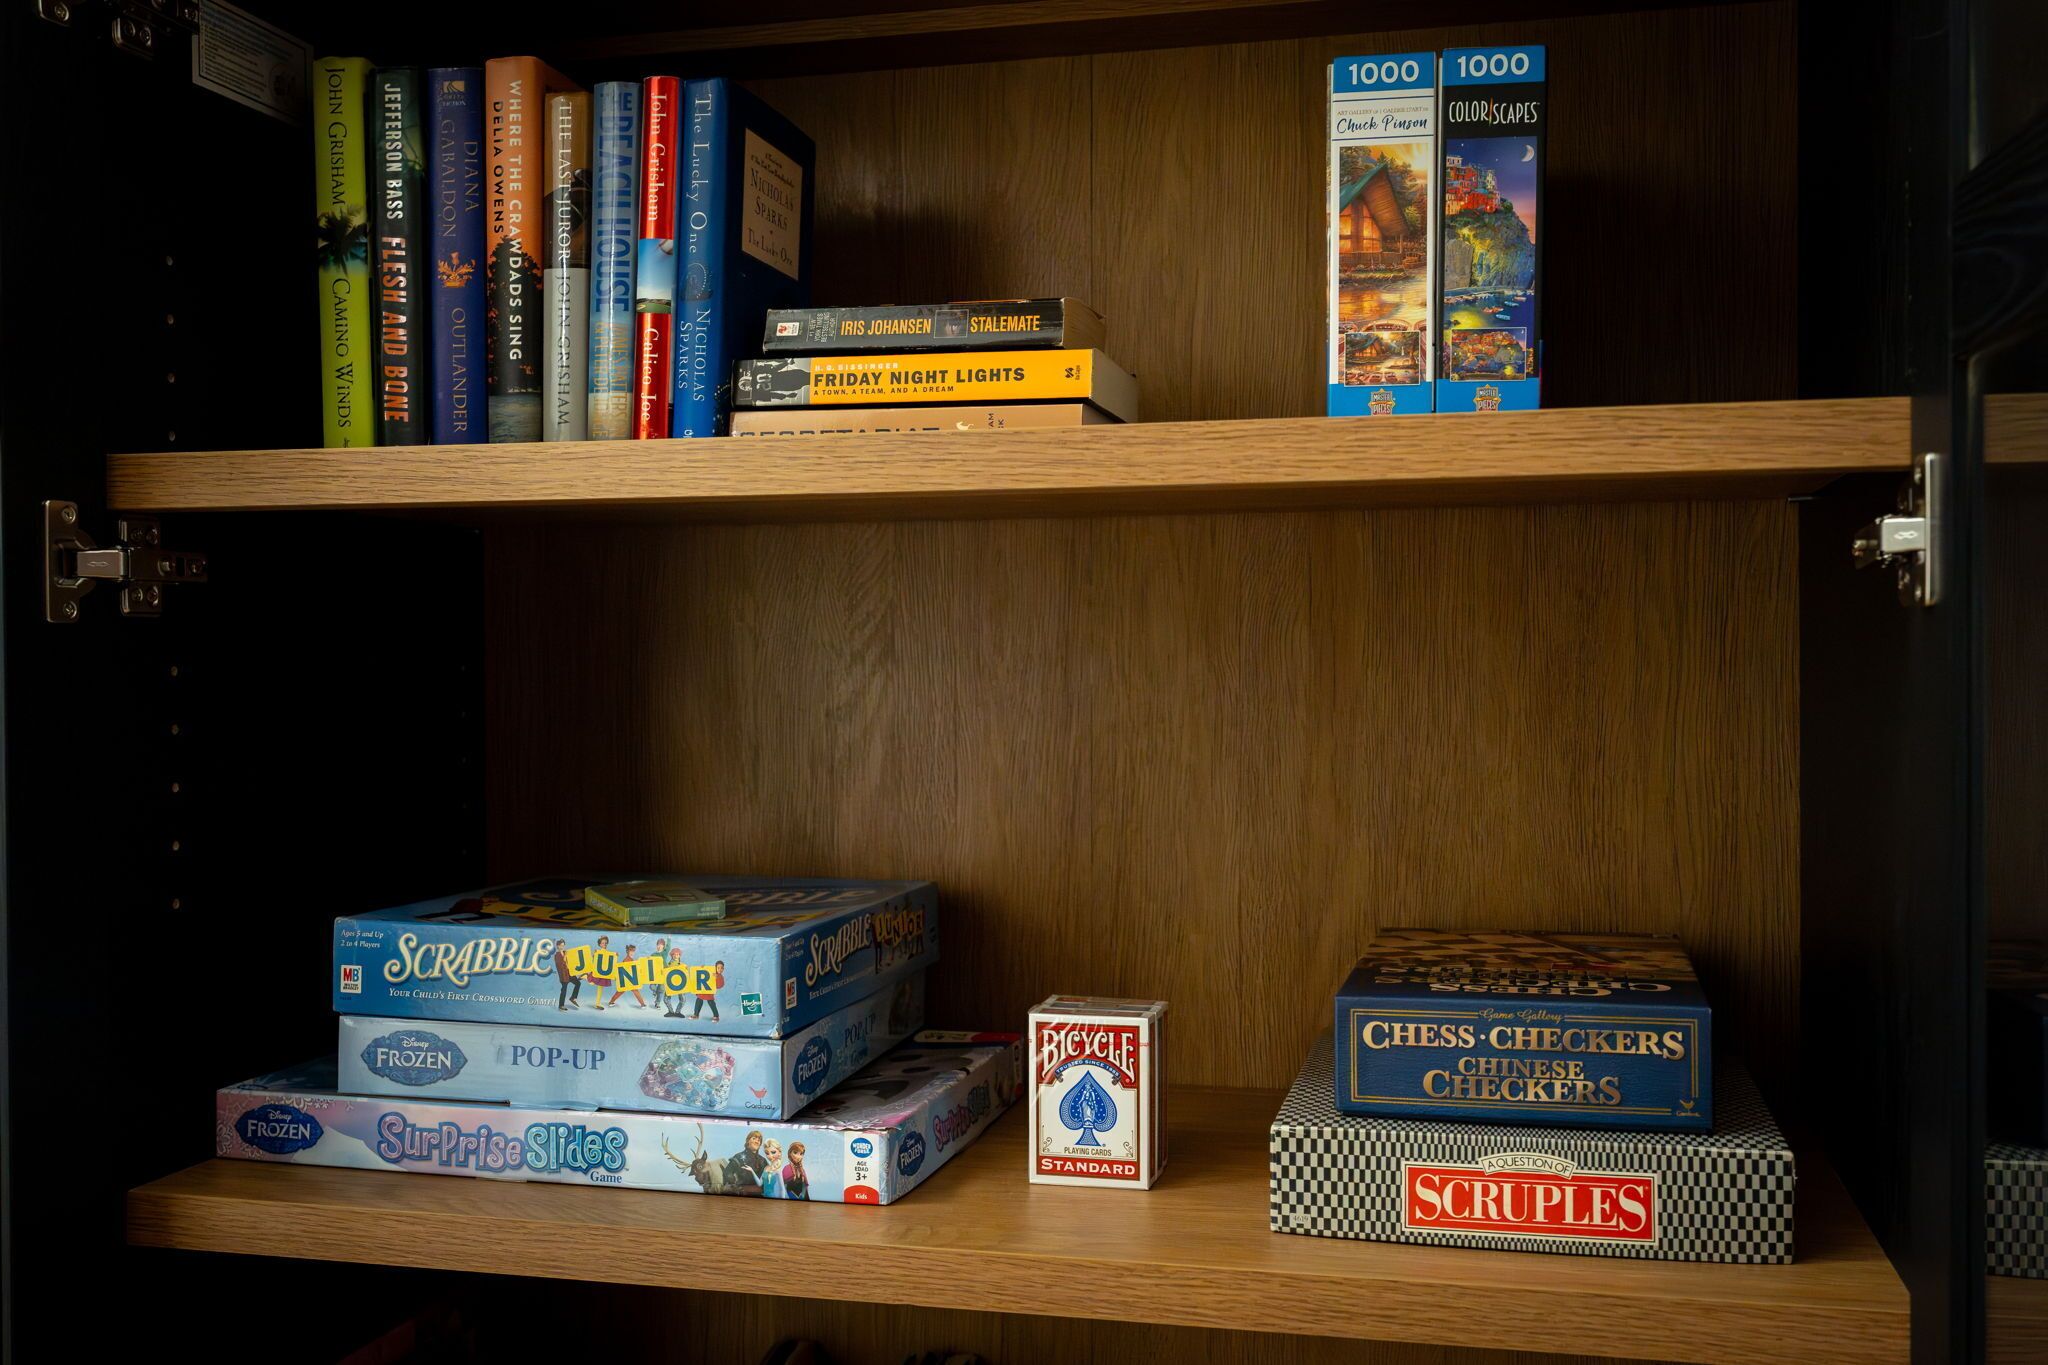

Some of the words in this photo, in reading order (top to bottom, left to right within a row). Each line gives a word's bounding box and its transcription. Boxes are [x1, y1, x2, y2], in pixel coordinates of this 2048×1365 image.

[1349, 60, 1420, 85] 1000
[1457, 52, 1530, 78] 1000
[324, 67, 346, 115] JOHN
[384, 83, 402, 173] JEFFERSON
[493, 101, 504, 158] DELIA
[509, 80, 522, 147] WHERE
[558, 101, 573, 139] THE
[650, 93, 668, 137] John
[694, 93, 713, 133] The
[1336, 115, 1379, 134] Chuck
[1381, 114, 1428, 132] Pinson
[328, 121, 348, 206] GRISHAM
[439, 119, 457, 238] GABALDON
[463, 141, 481, 213] DIANA
[509, 155, 522, 191] THE
[558, 148, 573, 192] LAST
[597, 116, 634, 208] BEACH
[648, 143, 667, 221] Grisham
[686, 141, 710, 203] Lucky
[386, 179, 403, 220] BASS
[493, 165, 504, 234] OWENS
[751, 168, 794, 212] NICHOLAS
[557, 196, 572, 261] JUROR
[689, 211, 708, 253] One
[755, 196, 788, 232] SPARKS
[382, 236, 407, 304] FLESH
[509, 199, 523, 308] CRAWDADS
[595, 218, 632, 313] HOUSE
[557, 276, 572, 326] JOHN
[382, 312, 408, 357] AND
[509, 314, 523, 360] SING
[840, 319, 866, 336] IRIS
[867, 318, 932, 336] JOHANSEN
[970, 314, 1041, 333] STALEMATE
[451, 307, 468, 433] OUTLANDER
[642, 327, 660, 385] Calico
[678, 320, 693, 389] SPARKS
[693, 309, 711, 402] NICHOLAS
[384, 365, 410, 424] BONE
[557, 334, 572, 425] GRISHAM
[814, 371, 882, 387] FRIDAY
[890, 369, 949, 385] NIGHT
[956, 366, 1026, 383] LIGHTS
[923, 385, 955, 393] DREAM
[640, 393, 658, 421] Joe
[341, 929, 356, 938] Ages
[374, 931, 384, 939] Up
[359, 940, 381, 949] Players
[806, 913, 872, 987] SCRABBLE
[343, 967, 360, 982] MB
[384, 932, 555, 987] SCRABBLE
[574, 949, 713, 992] JUNIOR
[389, 987, 410, 998] YOUR
[412, 989, 445, 1000] CHILD'S
[447, 991, 470, 1002] FIRST
[472, 992, 525, 1006] CROSSWORD
[1480, 1007, 1515, 1021] Game
[1517, 1009, 1564, 1024] Gallery
[376, 1047, 452, 1071] FROZEN
[401, 1036, 429, 1051] Disney
[511, 1045, 606, 1071] POP-UP
[1041, 1029, 1135, 1083] BICYCLE
[1362, 1020, 1475, 1050] CHESS
[1488, 1026, 1686, 1061] CHECKERS
[798, 1050, 828, 1086] FROZEN
[1085, 1060, 1105, 1068] SINCE
[1457, 1056, 1585, 1081] CHINESE
[1422, 1069, 1622, 1106] CHECKERS
[247, 1120, 311, 1140] FROZEN
[268, 1109, 292, 1122] Disney
[900, 1141, 923, 1169] FROZEN
[1041, 1158, 1135, 1175] STANDARD
[1064, 1146, 1090, 1156] PLAYING
[1090, 1148, 1112, 1157] CARDS
[1488, 1161, 1496, 1170] A
[1497, 1155, 1555, 1172] QUESTION
[1556, 1161, 1572, 1175] OF
[590, 1171, 623, 1184] Game
[855, 1172, 867, 1181] 3+
[1415, 1173, 1647, 1232] SCRUPLES
